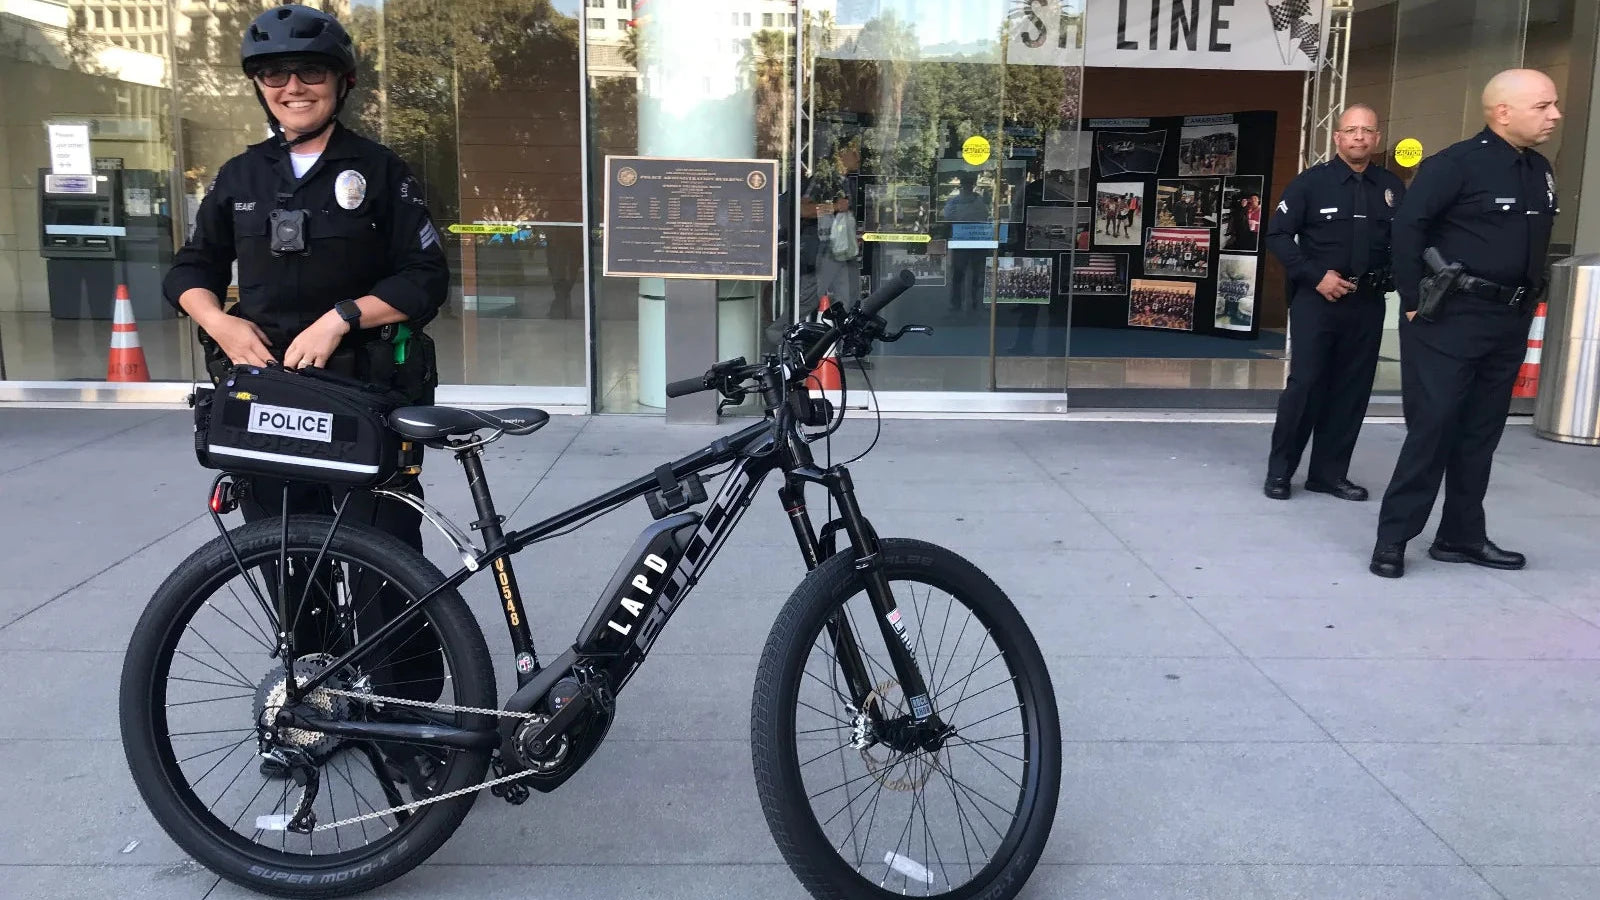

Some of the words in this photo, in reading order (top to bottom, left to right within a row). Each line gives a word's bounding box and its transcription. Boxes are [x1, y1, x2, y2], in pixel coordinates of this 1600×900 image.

[1116, 0, 1232, 52] LINE
[259, 411, 328, 433] POLICE
[635, 470, 750, 651] BULLS
[607, 552, 668, 636] LAPD
[247, 864, 315, 884] SUPER
